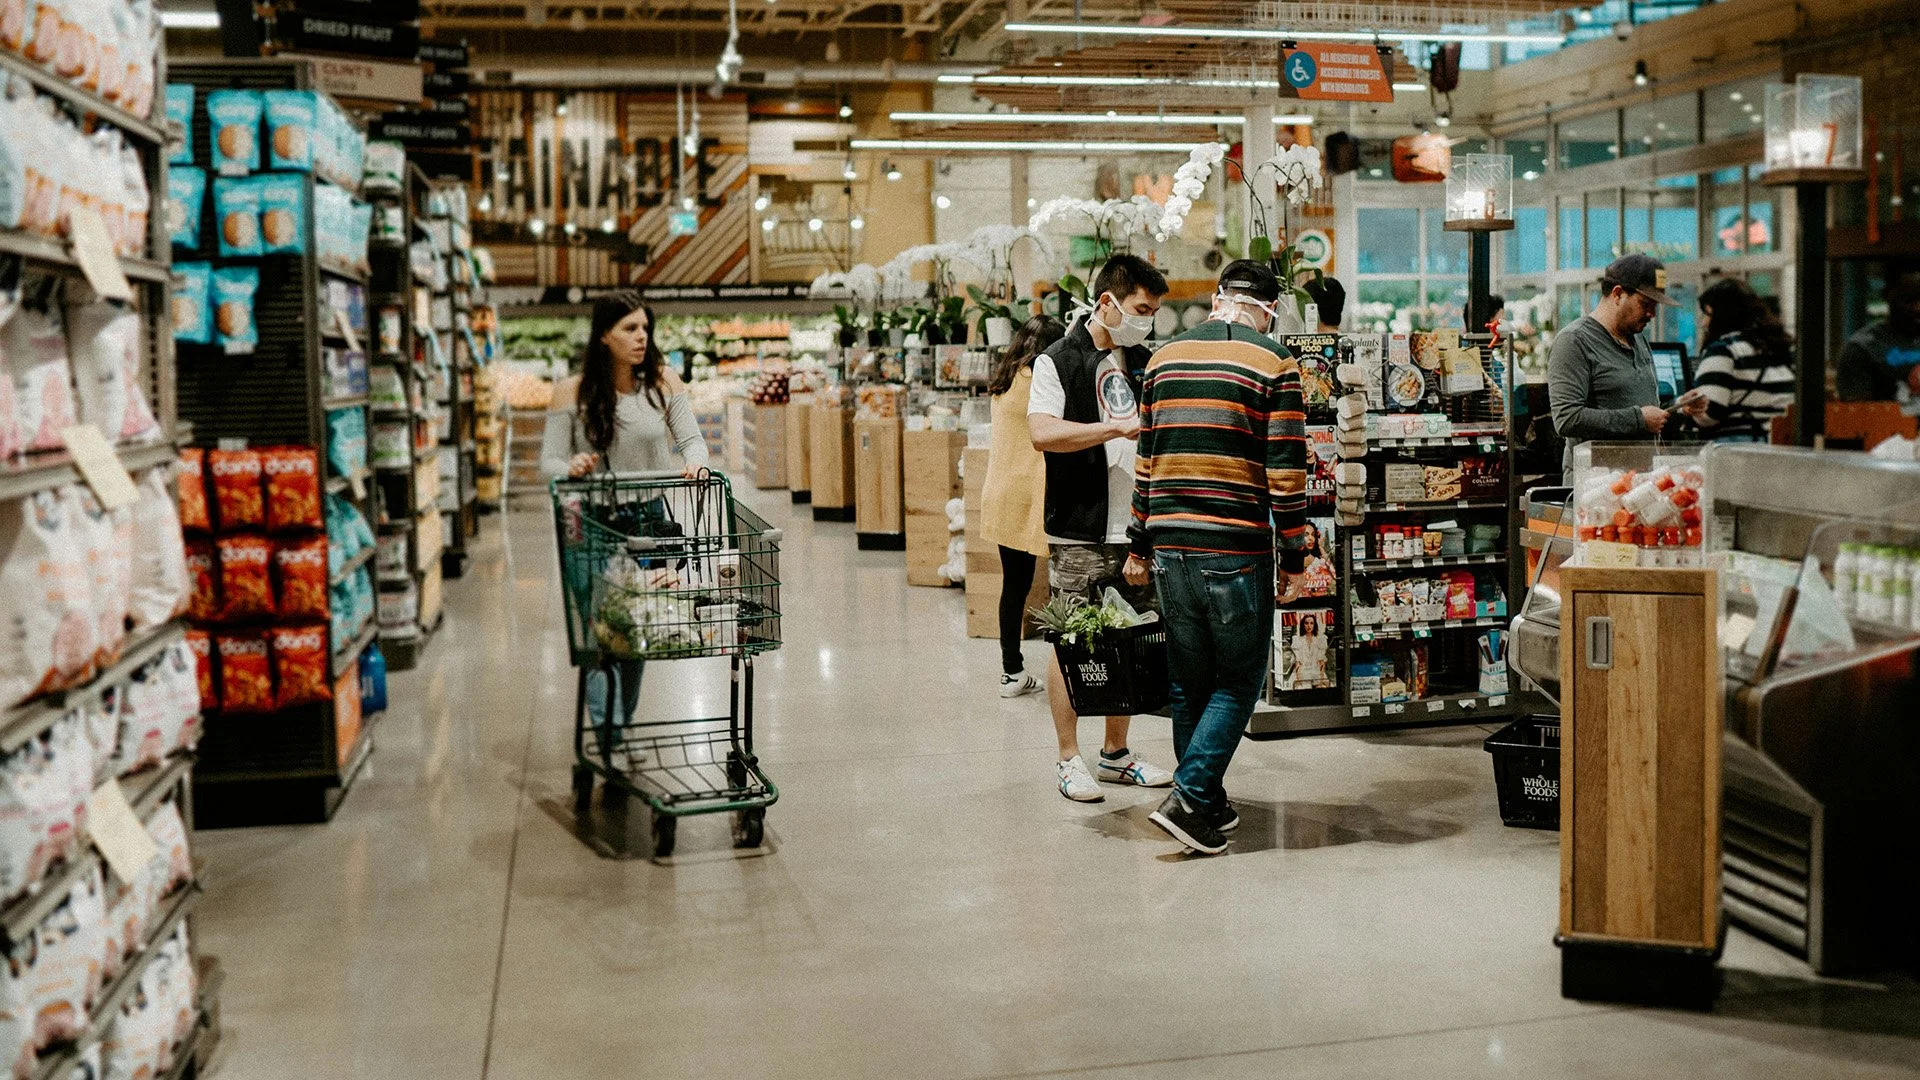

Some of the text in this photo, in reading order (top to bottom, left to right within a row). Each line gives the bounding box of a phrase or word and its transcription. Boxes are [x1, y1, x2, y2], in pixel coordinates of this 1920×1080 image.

[303, 18, 394, 42] DRIED FRUIT
[1822, 122, 1838, 166] 7
[1286, 338, 1335, 347] PLANT-BASED
[1301, 345, 1322, 353] FOOD
[1437, 469, 1454, 481] dang
[1437, 486, 1454, 497] dang
[1078, 662, 1107, 672] WHOLE
[1082, 672, 1108, 681] FOODS
[1522, 776, 1559, 788] WHOLE
[1524, 786, 1558, 798] FOODS
